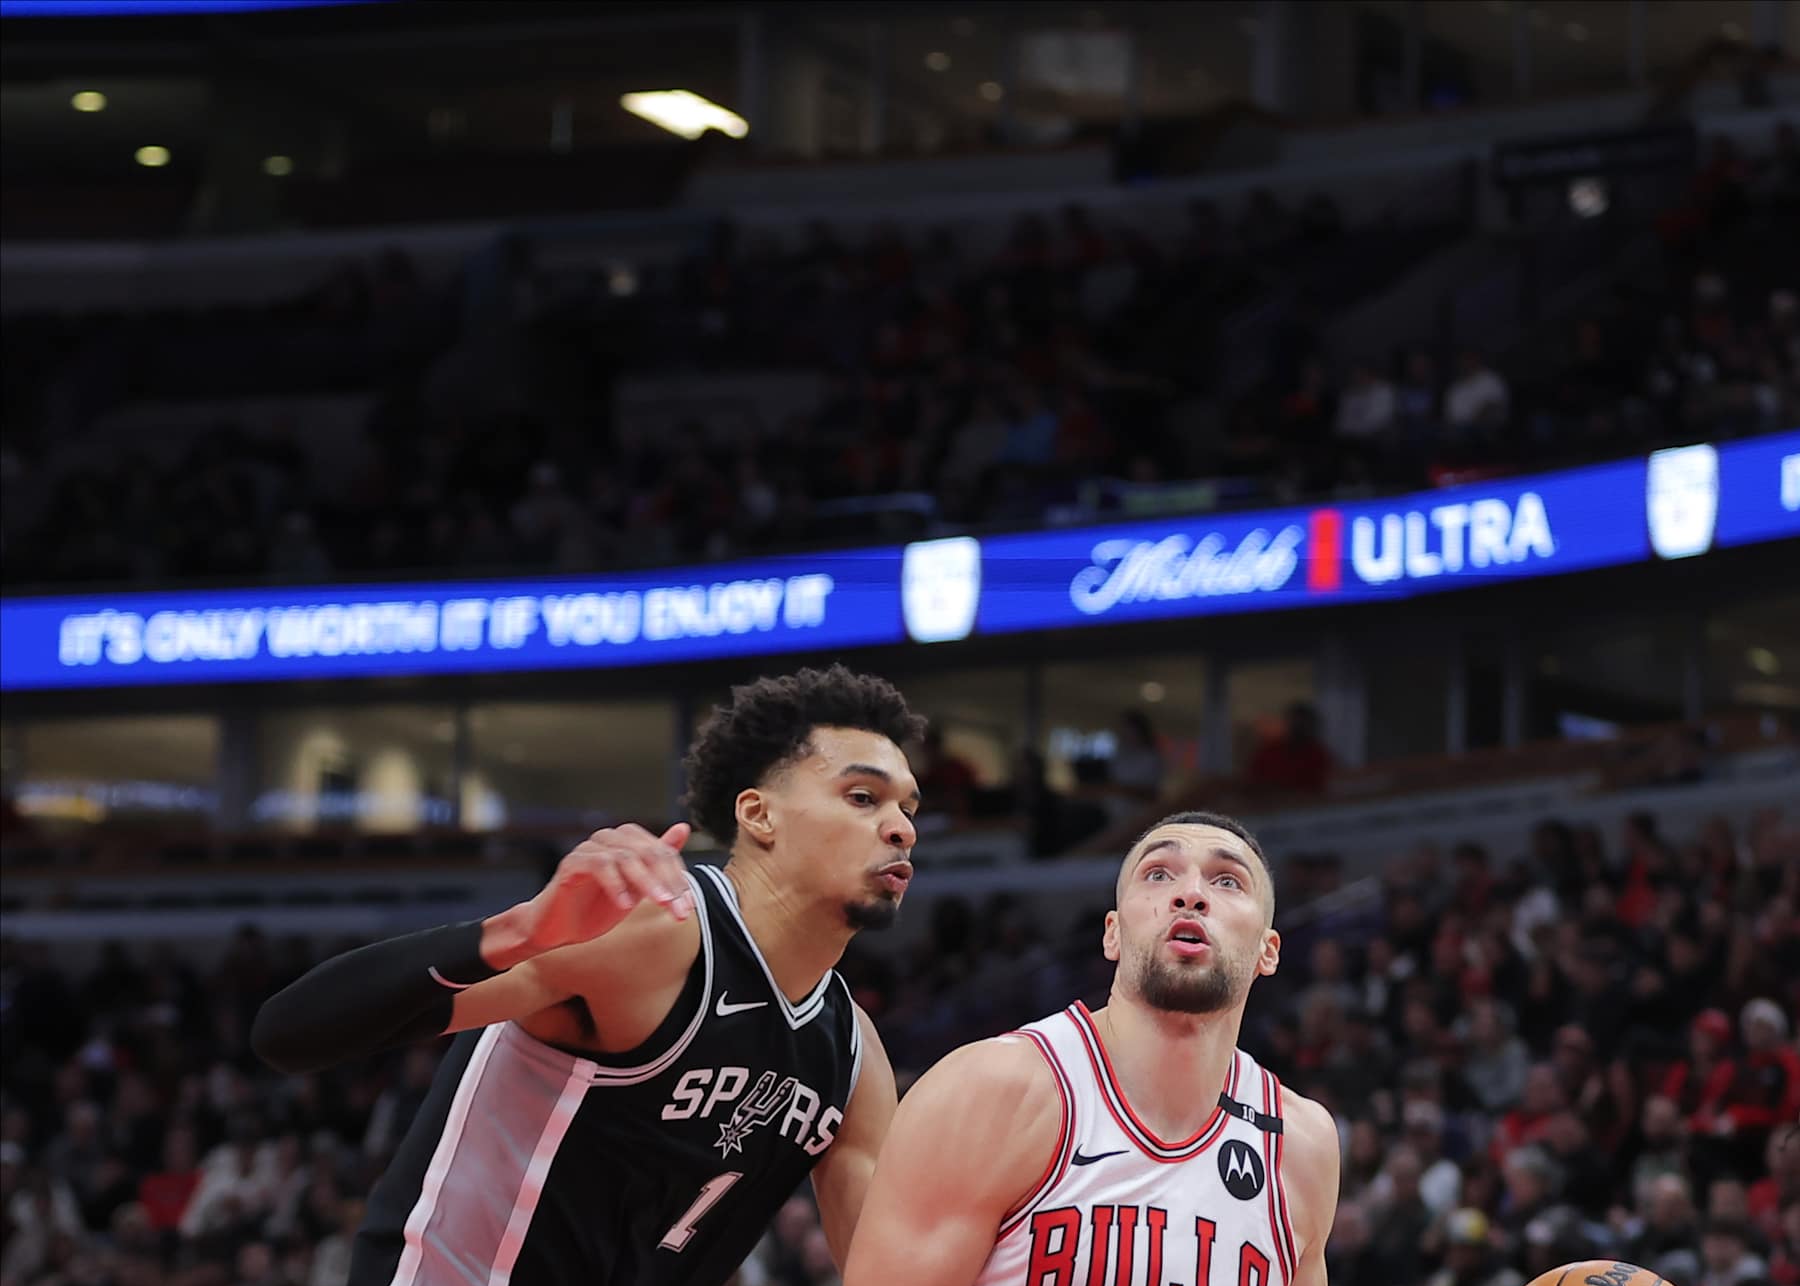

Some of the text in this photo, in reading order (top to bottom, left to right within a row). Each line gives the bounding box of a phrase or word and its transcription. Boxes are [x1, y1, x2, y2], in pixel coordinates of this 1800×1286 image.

[1352, 492, 1556, 584] ULTRA
[58, 573, 834, 666] IT'S ONLY WORTH IT IF YOU ENJOY IT
[661, 1066, 844, 1160] SPURS
[1241, 1105, 1256, 1124] 10
[656, 1171, 744, 1253] 1
